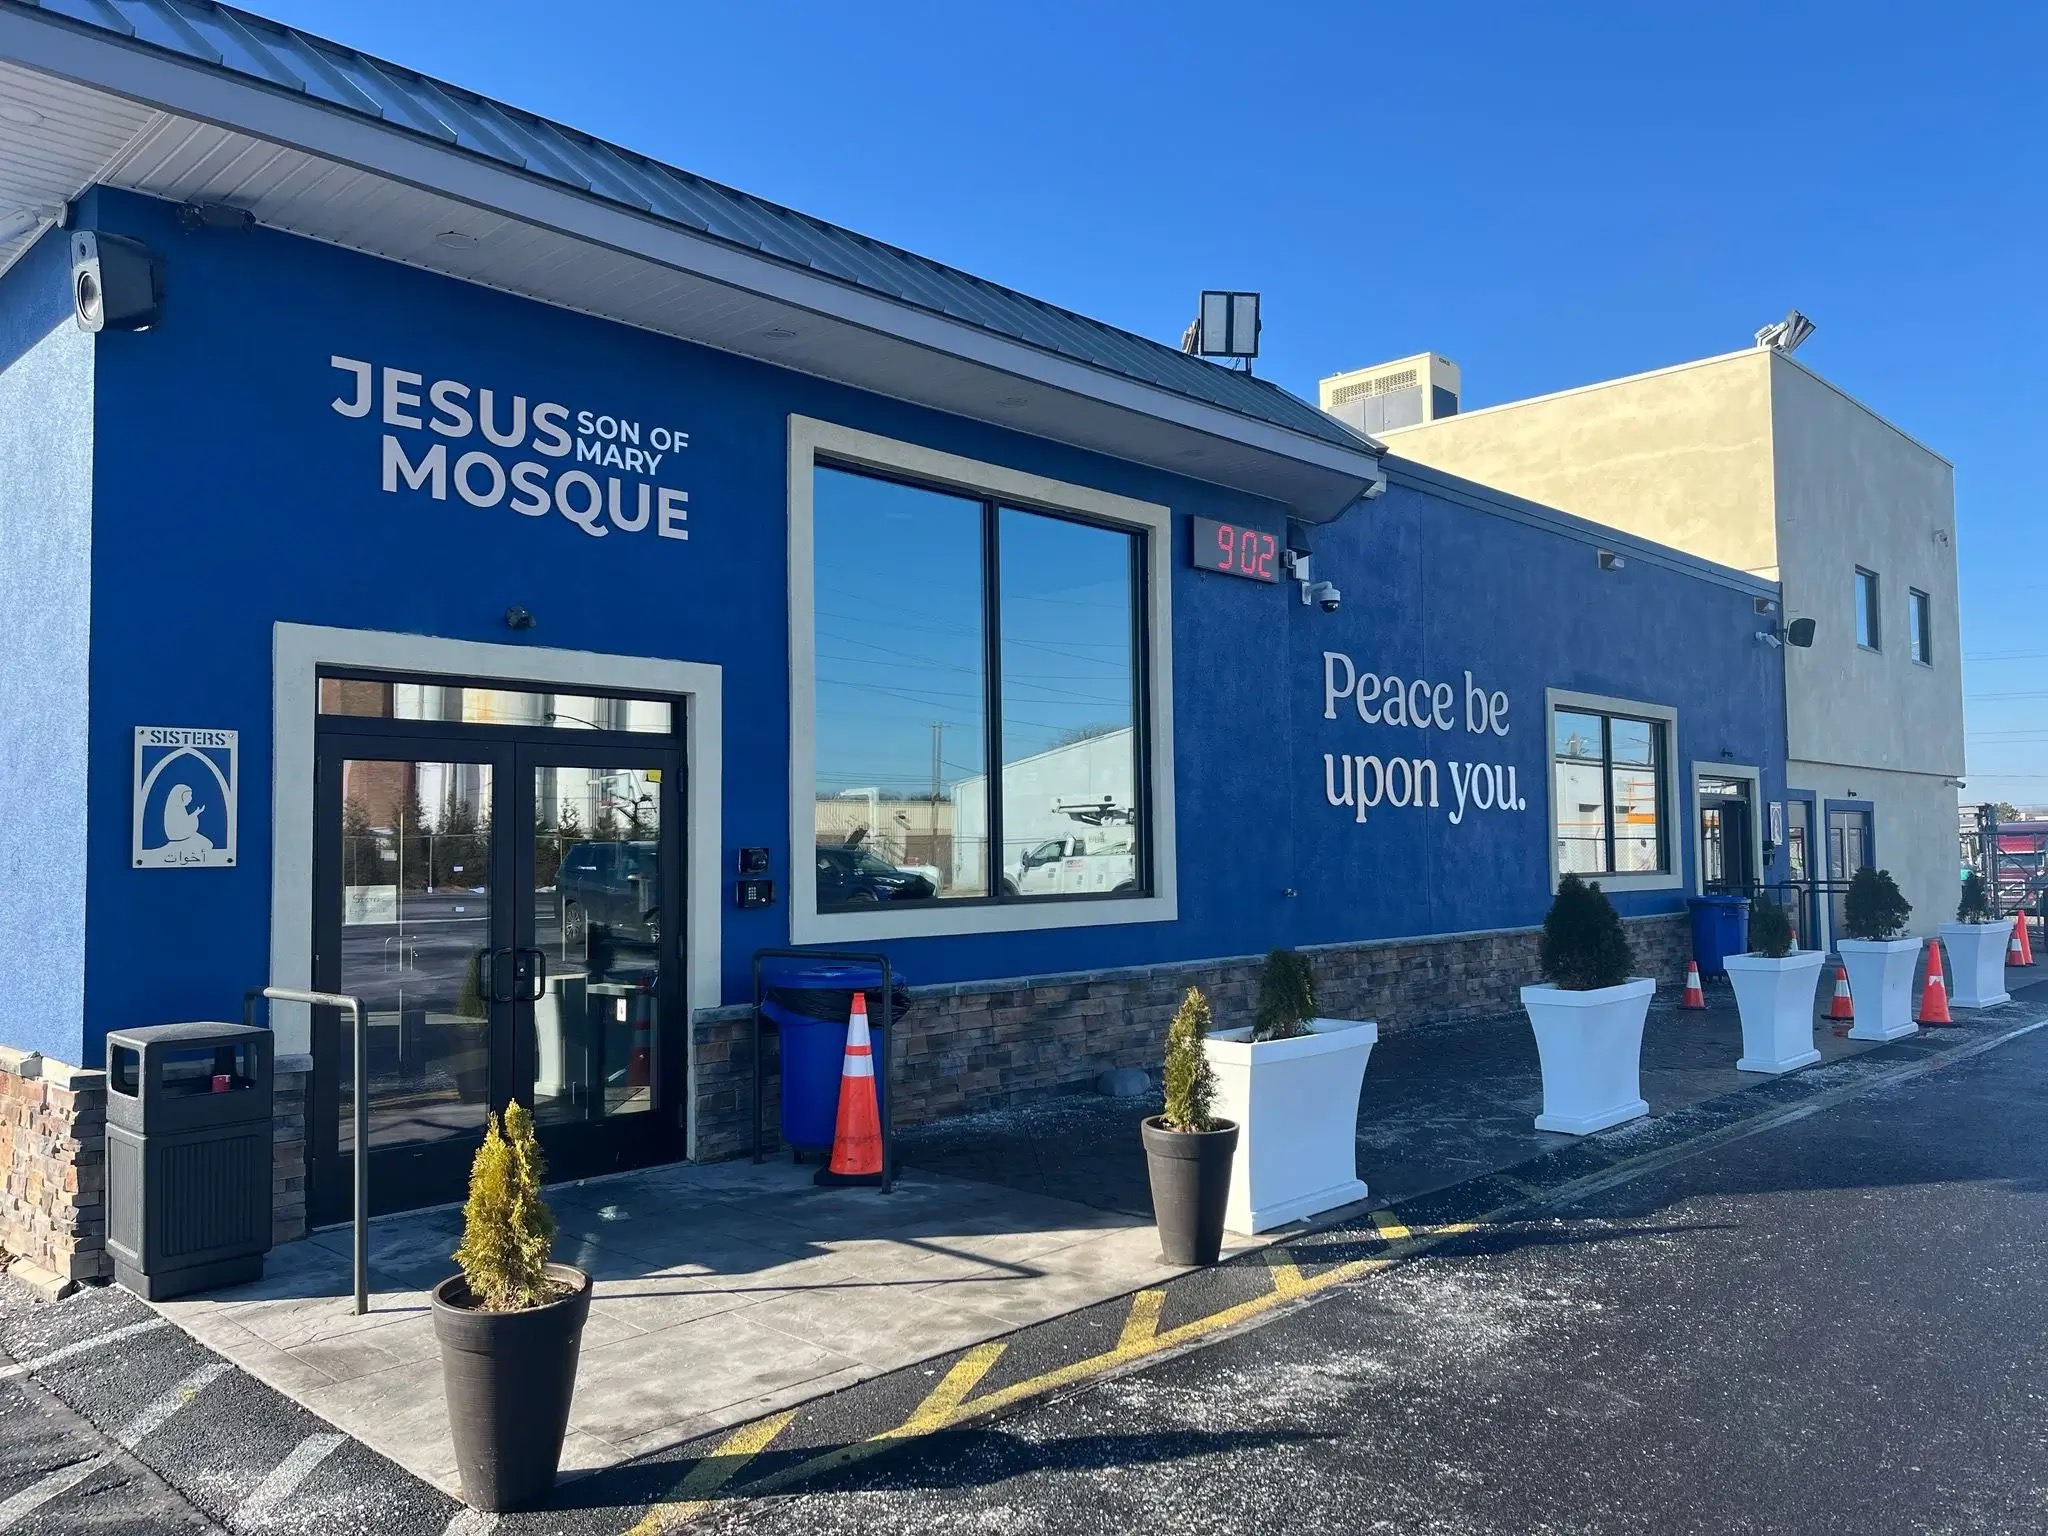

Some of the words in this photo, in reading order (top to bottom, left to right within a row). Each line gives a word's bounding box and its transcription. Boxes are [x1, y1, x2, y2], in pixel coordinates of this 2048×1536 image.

[331, 355, 572, 457] JESUS
[577, 411, 640, 444] SON
[650, 427, 689, 453] OF
[576, 437, 663, 475] MARY
[381, 434, 689, 540] MOSQUE
[1323, 651, 1454, 730] Peace
[1464, 670, 1510, 736] be
[150, 729, 226, 746] SISTERS
[1324, 753, 1439, 823] upon
[1448, 761, 1526, 824] you.
[163, 848, 206, 866] أخوات
